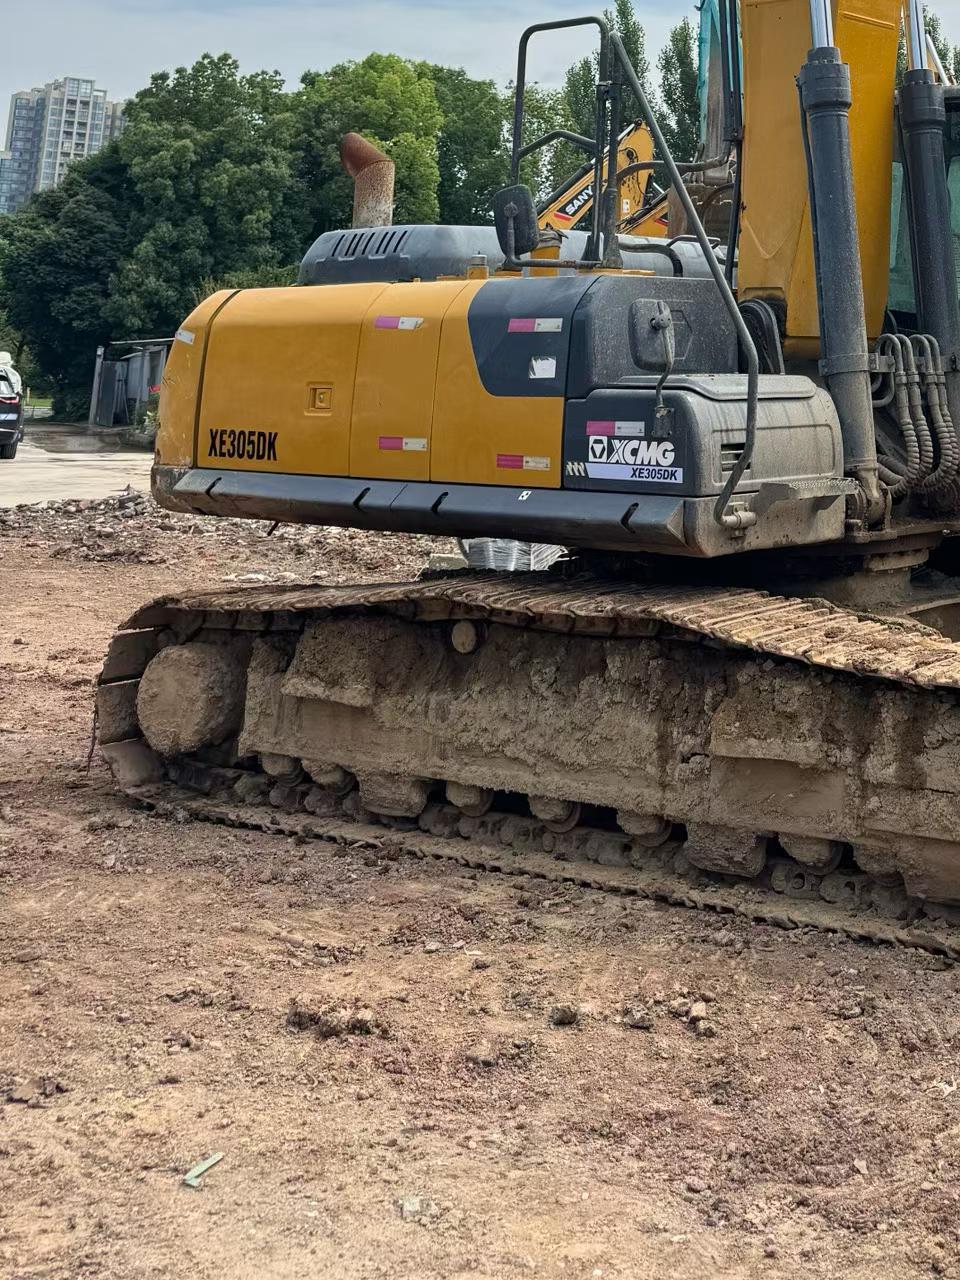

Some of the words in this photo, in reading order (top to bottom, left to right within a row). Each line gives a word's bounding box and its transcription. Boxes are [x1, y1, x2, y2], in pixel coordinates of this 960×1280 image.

[565, 184, 595, 215] SANY
[208, 429, 278, 461] XE305DK
[607, 439, 675, 466] XCMG
[630, 467, 678, 480] XE305DK
